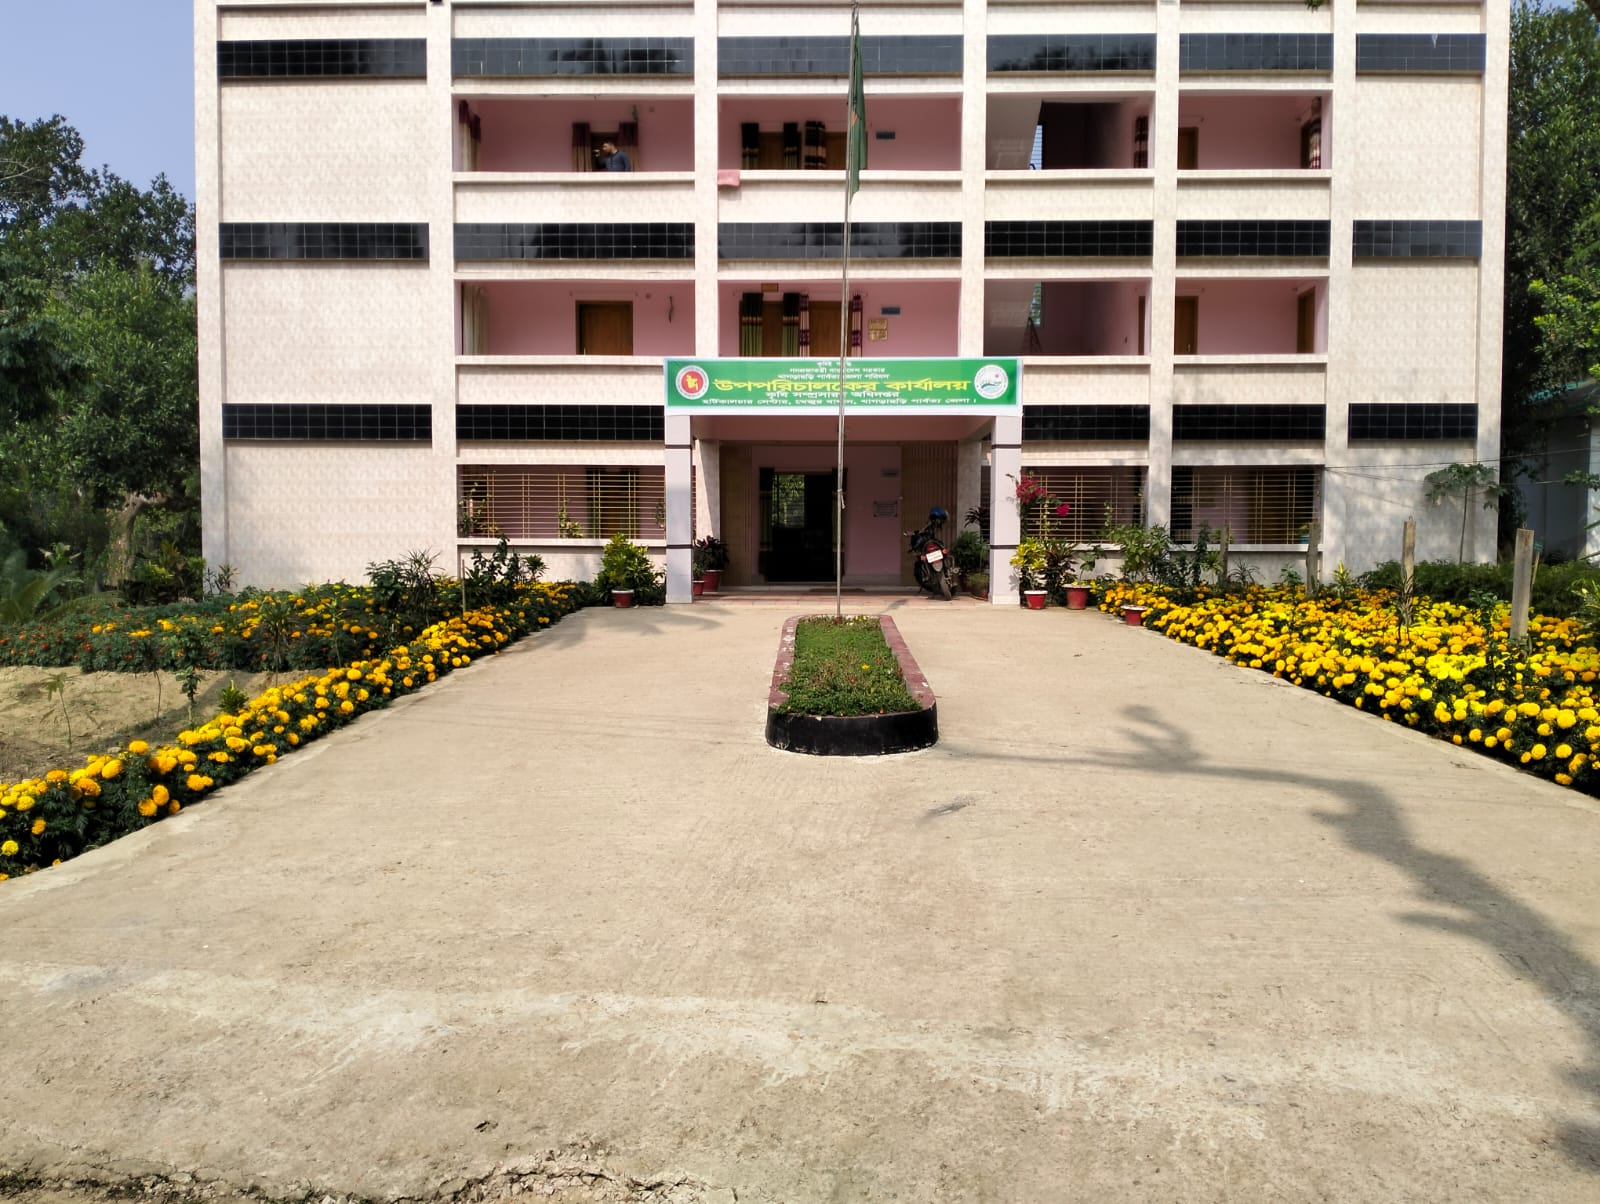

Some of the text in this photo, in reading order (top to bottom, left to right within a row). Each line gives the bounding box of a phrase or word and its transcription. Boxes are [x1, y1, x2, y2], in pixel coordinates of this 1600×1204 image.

[713, 378, 880, 392] উপপরিচালকের
[885, 377, 971, 391] কার্যালয়
[765, 391, 788, 401] কৃষি
